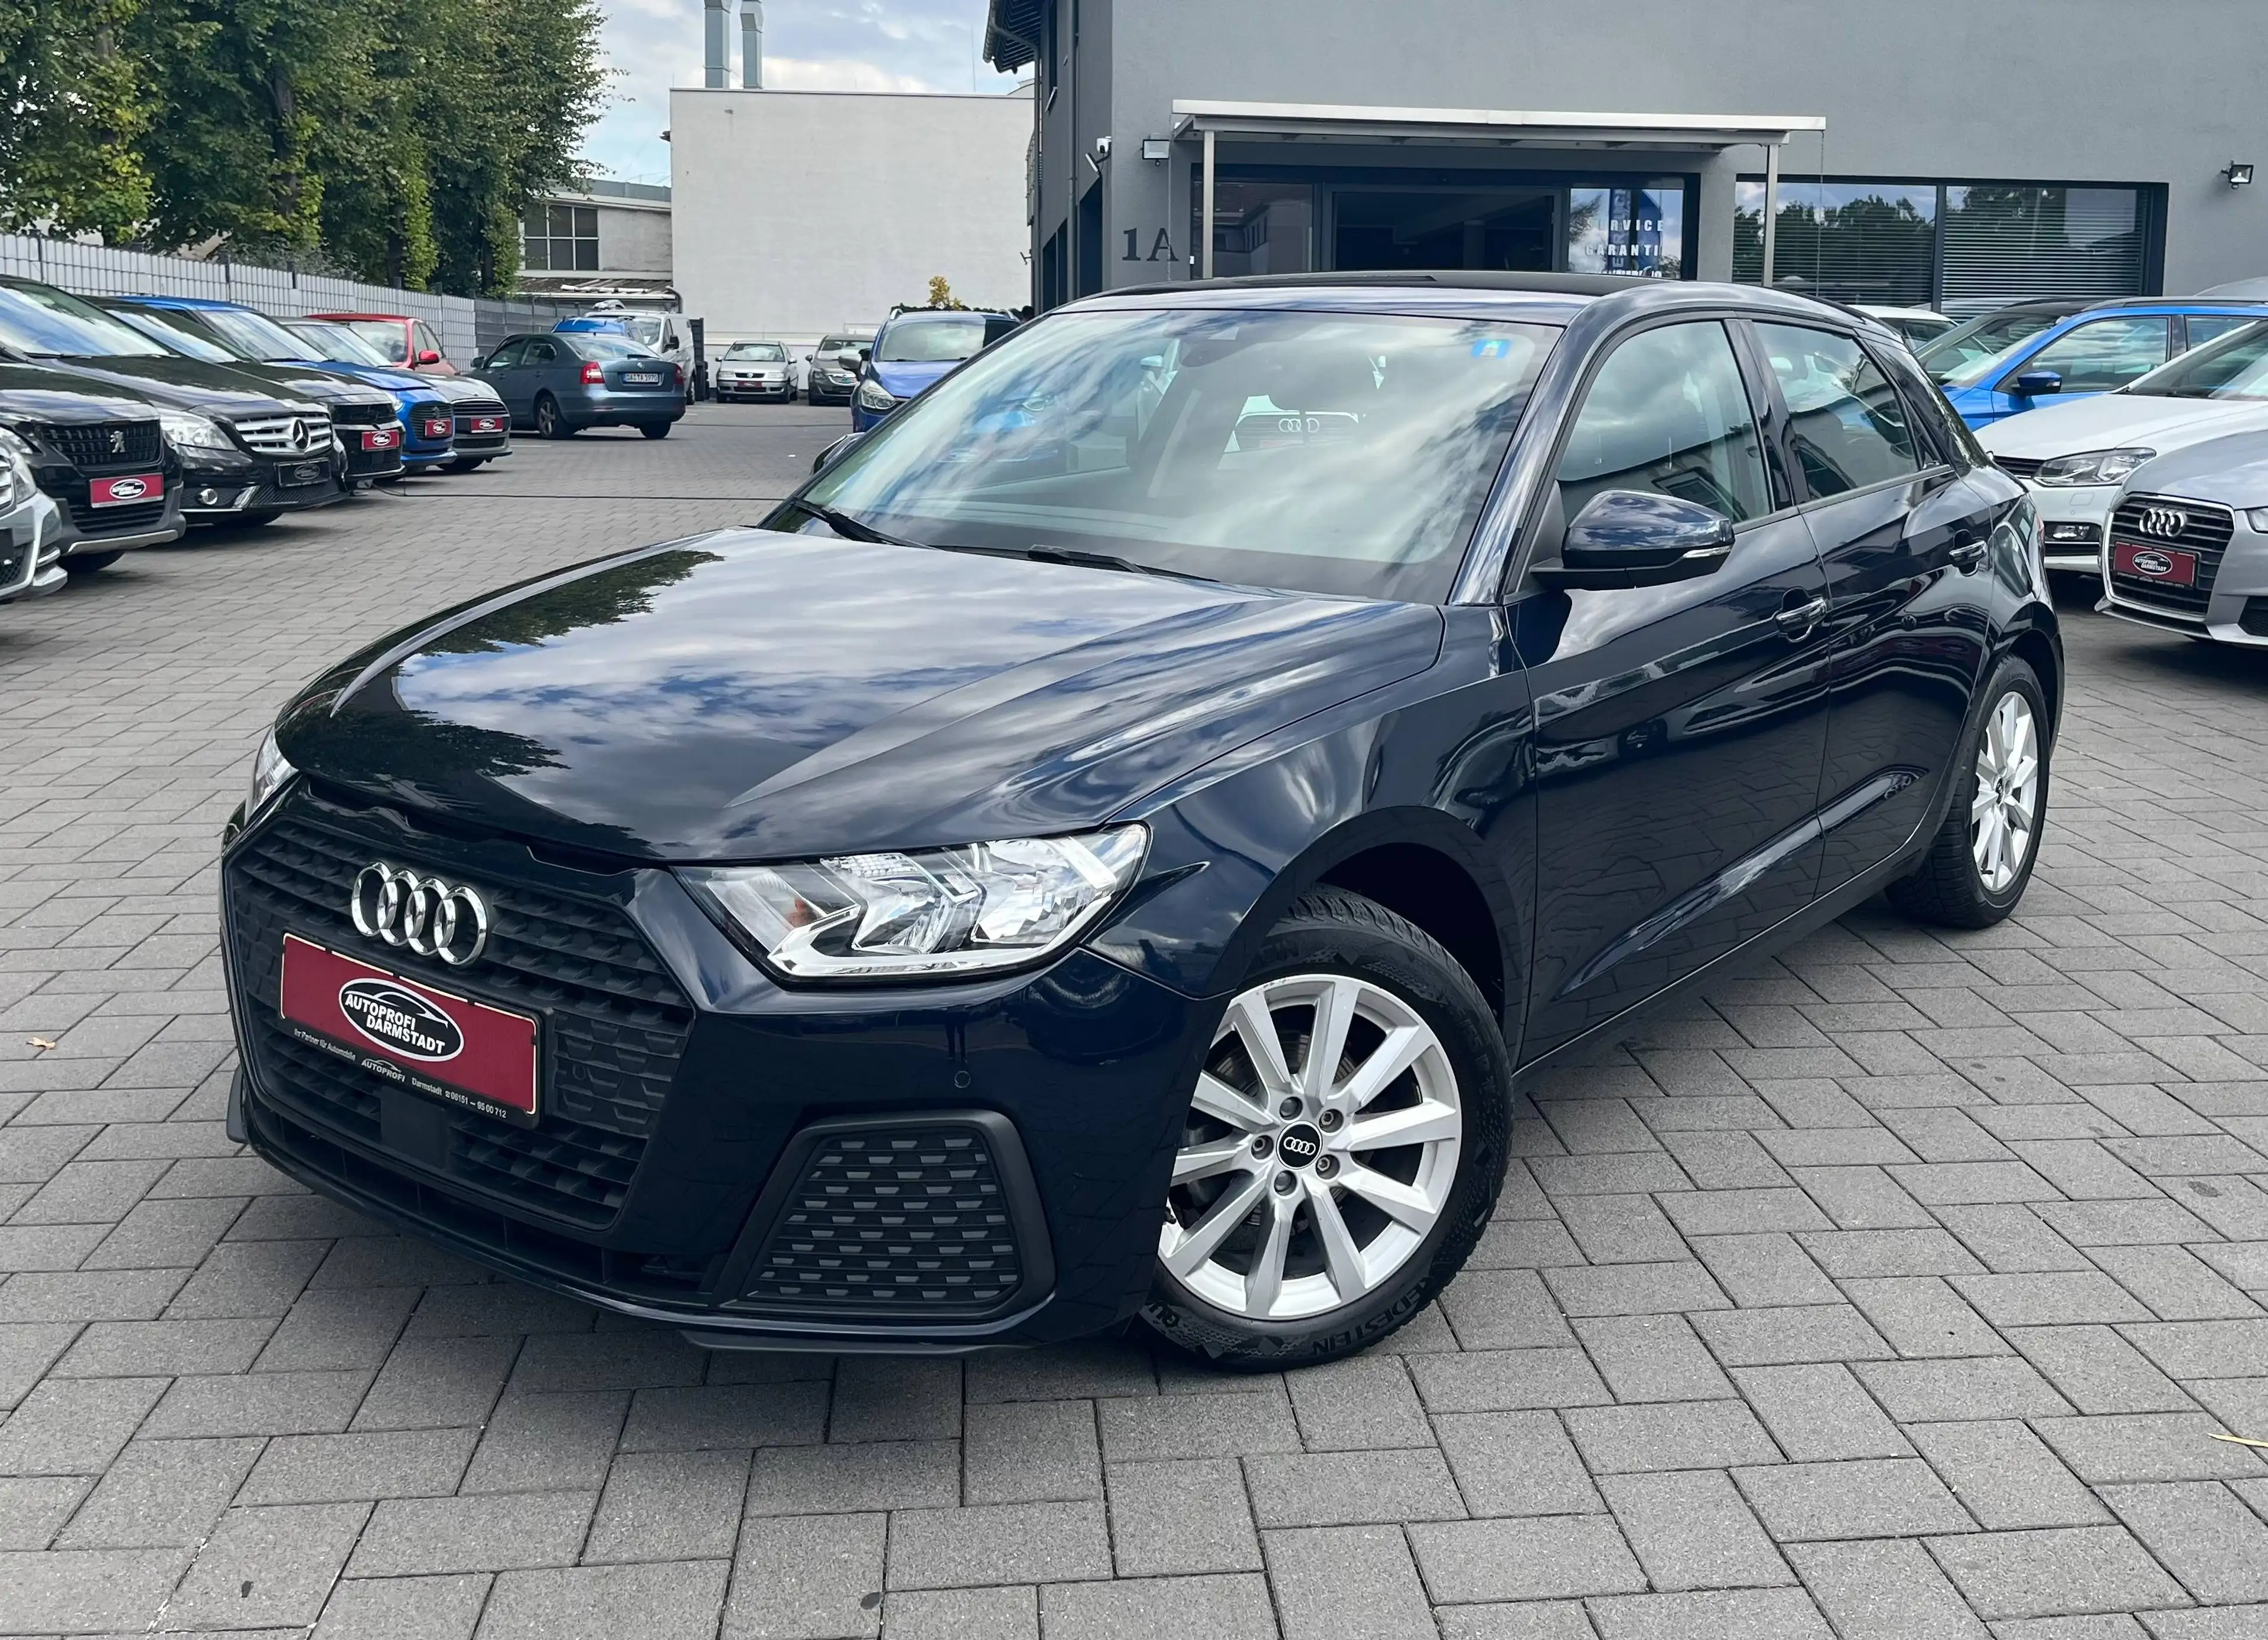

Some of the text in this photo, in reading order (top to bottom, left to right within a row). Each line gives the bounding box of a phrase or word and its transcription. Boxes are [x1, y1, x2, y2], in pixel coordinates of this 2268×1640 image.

[1596, 219, 1664, 232] RVICE
[1122, 227, 1179, 262] 1A
[1585, 244, 1660, 256] GARANTI
[344, 993, 416, 1031] AUTOPROFI
[366, 1015, 445, 1054] DARMSTADT
[361, 1060, 406, 1083] AUTOPROFI
[412, 1077, 442, 1096] Darmstadt
[495, 1107, 507, 1119] 712
